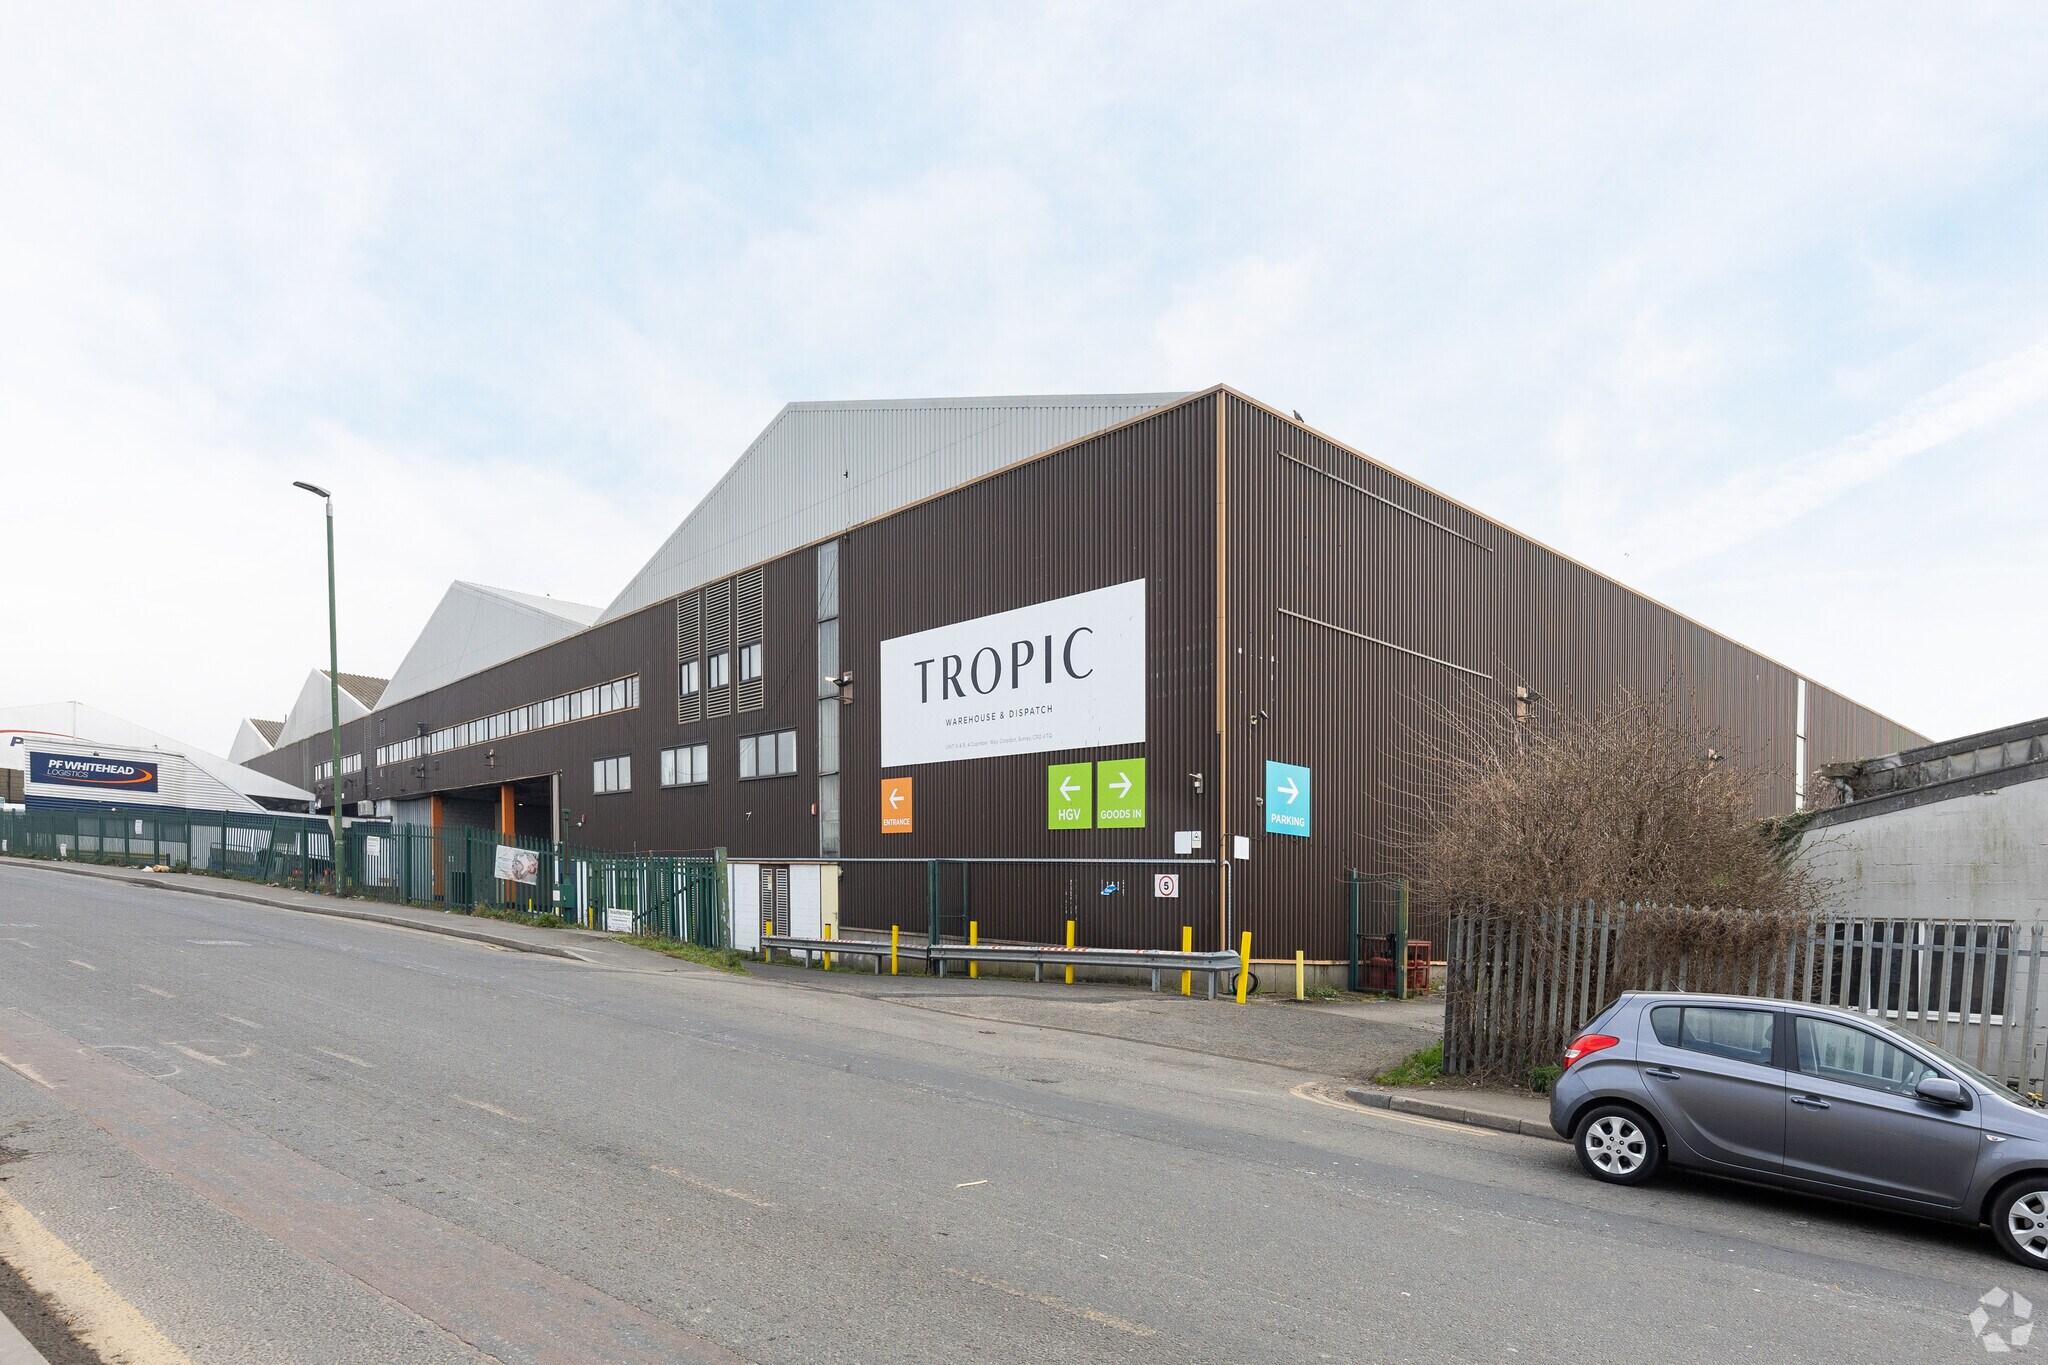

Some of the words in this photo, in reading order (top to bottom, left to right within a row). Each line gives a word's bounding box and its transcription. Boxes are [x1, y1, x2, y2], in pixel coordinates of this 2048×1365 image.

[914, 627, 1093, 703] TROPIC
[945, 712, 996, 726] WAREHOUSE
[1000, 711, 1005, 720] &
[1009, 704, 1053, 719] DISPATCH
[47, 768, 89, 778] LOGISTICS
[48, 759, 63, 769] PF
[64, 761, 135, 775] WHITEHEAD
[1058, 808, 1081, 821] HGV
[1100, 809, 1131, 820] GOODS
[1132, 809, 1142, 819] IN
[1271, 813, 1305, 827] PARKING
[883, 818, 910, 826] ENTRANCE
[1163, 881, 1170, 890] 5
